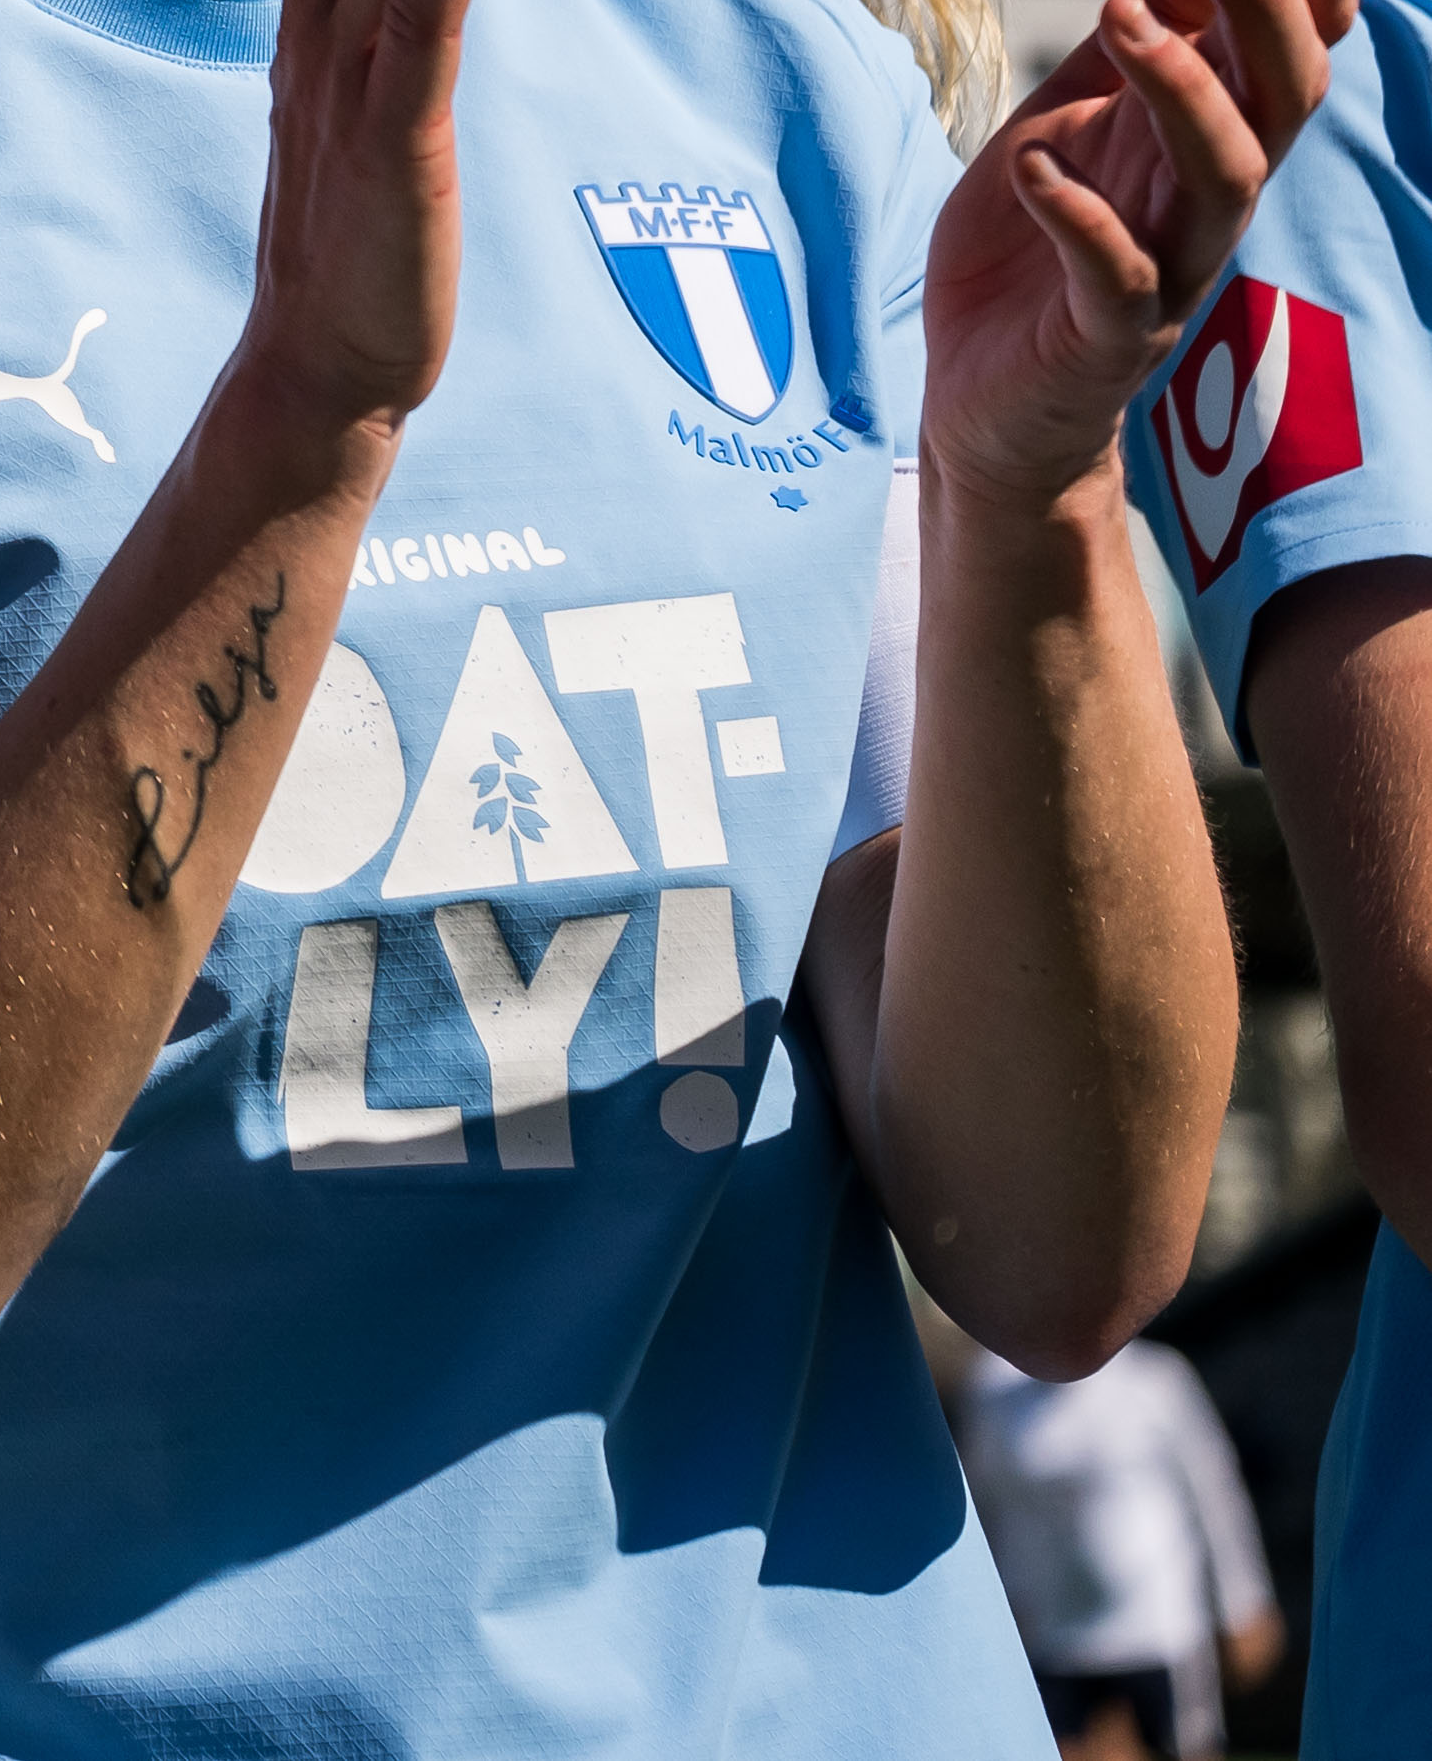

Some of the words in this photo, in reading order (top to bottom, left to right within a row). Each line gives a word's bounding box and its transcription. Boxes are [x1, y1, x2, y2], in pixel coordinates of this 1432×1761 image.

[667, 408, 823, 473] Malmö
[347, 526, 567, 590] RIGINAL
[277, 886, 746, 1171] LY!
